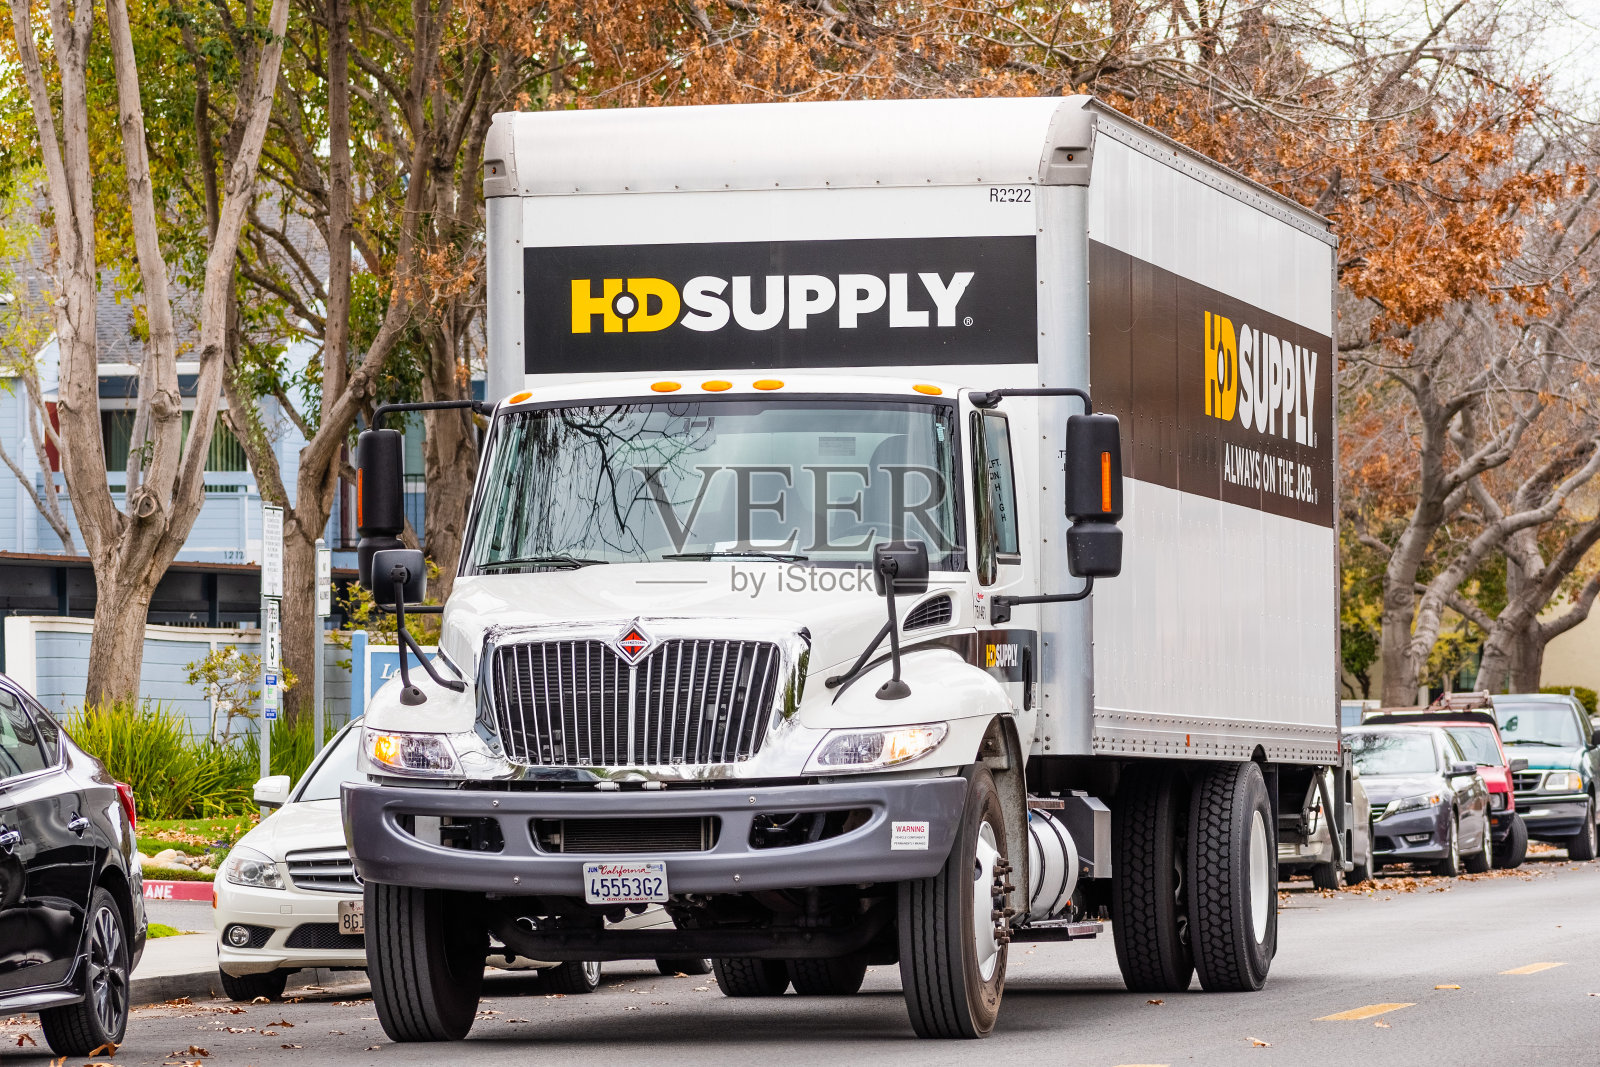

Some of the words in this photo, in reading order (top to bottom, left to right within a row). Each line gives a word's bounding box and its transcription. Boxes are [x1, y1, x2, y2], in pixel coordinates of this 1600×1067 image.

[1224, 443, 1260, 490] ALWAYS
[1263, 453, 1276, 494] ON
[1277, 457, 1294, 498] THE
[1296, 463, 1314, 503] JOB.
[270, 637, 275, 660] 5
[601, 865, 650, 877] California
[144, 885, 173, 898] ANE
[591, 877, 663, 897] 45553G2
